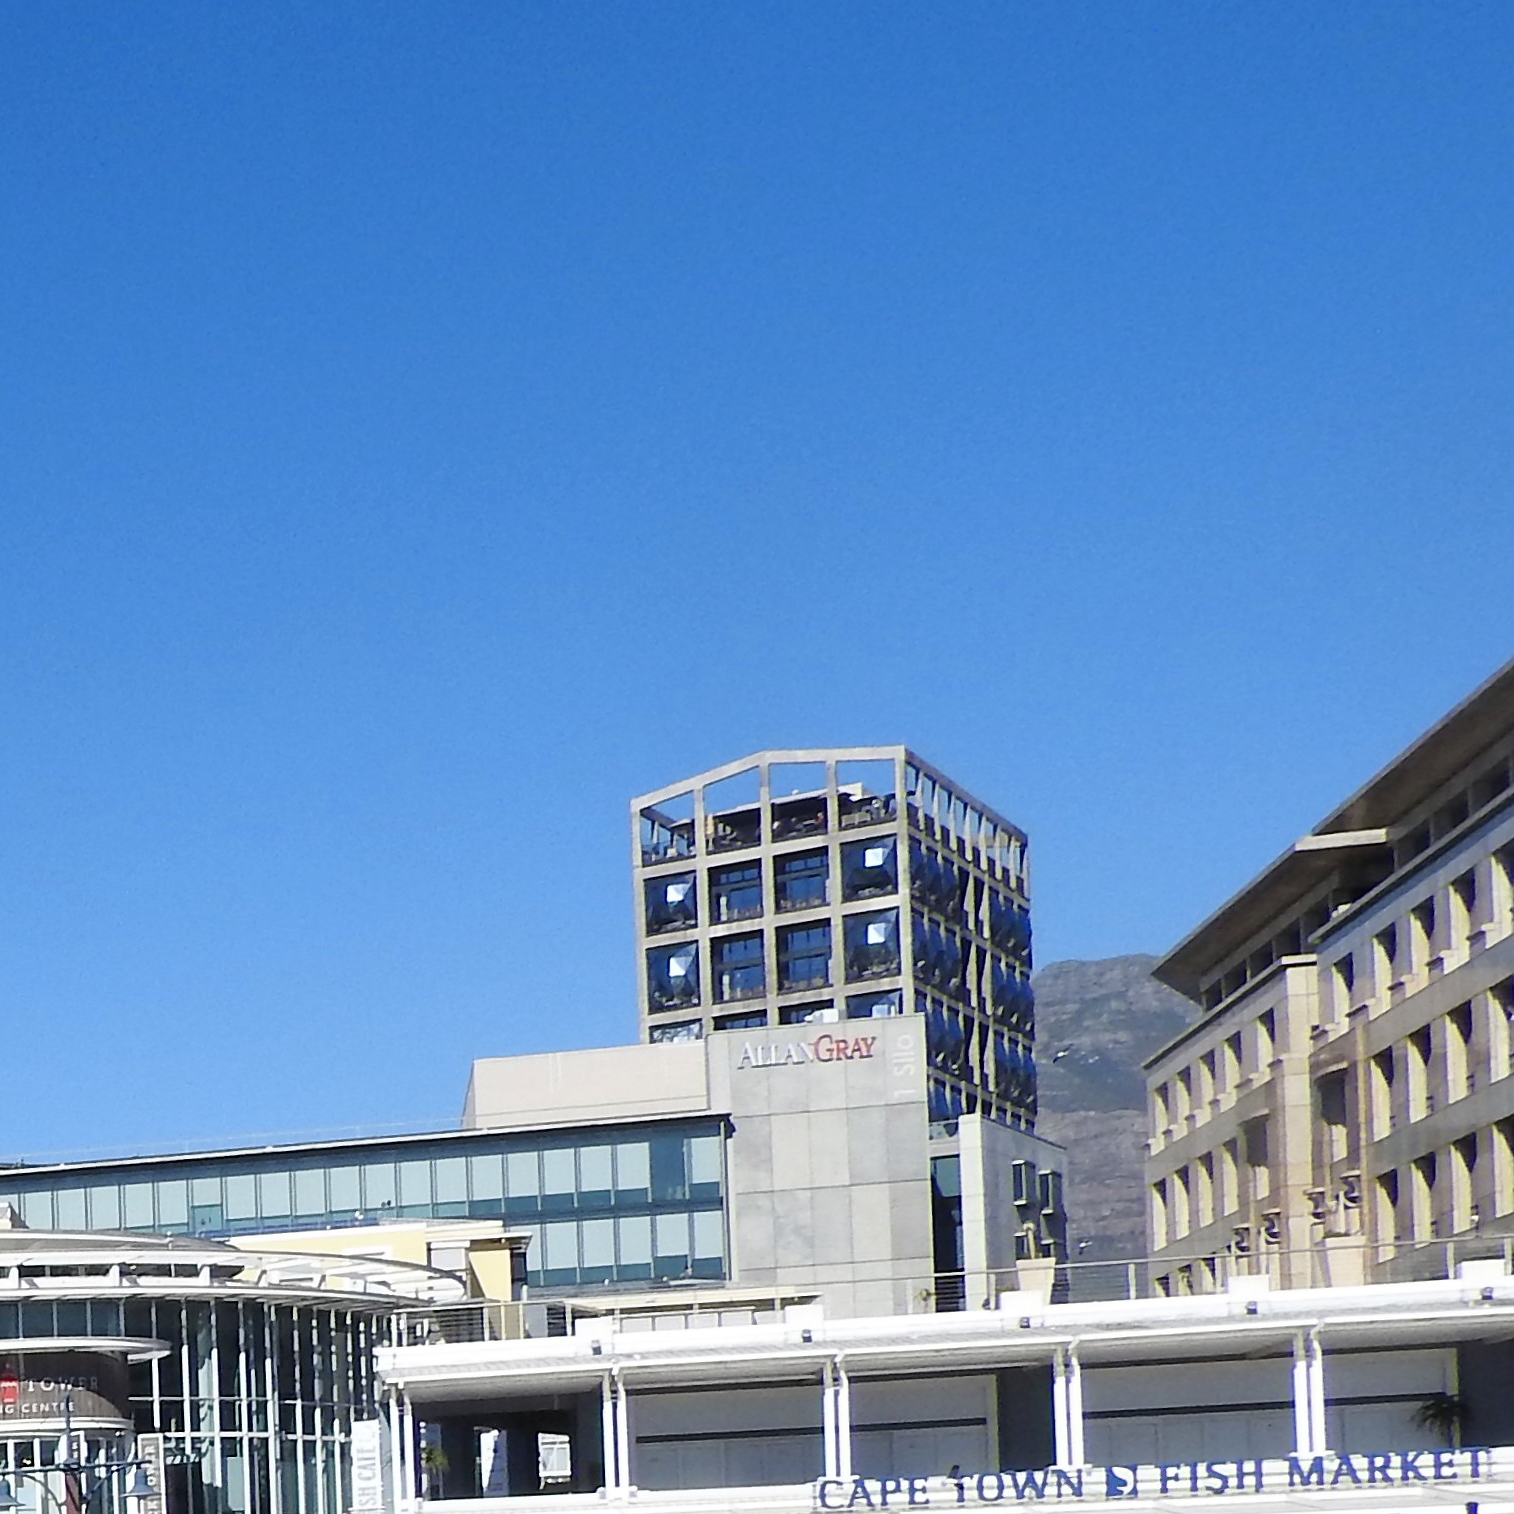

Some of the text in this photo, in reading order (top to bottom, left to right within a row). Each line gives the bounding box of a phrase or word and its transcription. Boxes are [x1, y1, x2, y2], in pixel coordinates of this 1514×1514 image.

[21, 1401, 75, 1413] CENTRE
[144, 1445, 158, 1491] OWER
[818, 1447, 1492, 1510] CAPE TOWN FISH MARKET
